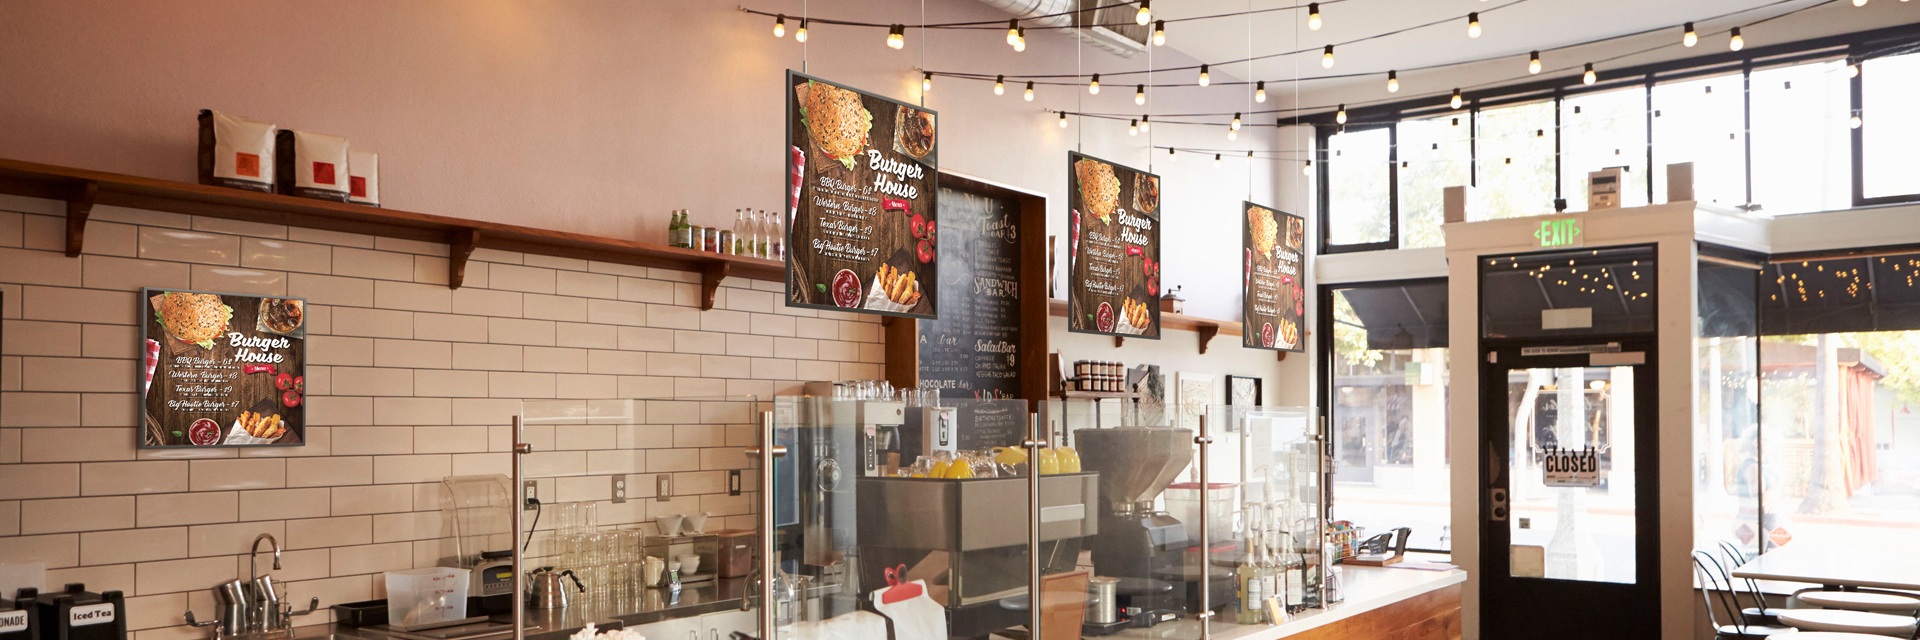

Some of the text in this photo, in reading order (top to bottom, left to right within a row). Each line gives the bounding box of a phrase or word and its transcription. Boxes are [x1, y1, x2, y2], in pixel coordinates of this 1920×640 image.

[868, 149, 924, 181] Burger
[820, 176, 834, 190] BBQ
[836, 180, 857, 194] Burger
[874, 172, 918, 199] House
[813, 196, 840, 209] Western
[843, 201, 864, 215] Burger
[820, 218, 837, 229] Texas
[838, 220, 858, 234] Burger
[978, 214, 1010, 235] Toast
[1118, 208, 1152, 232] Burger
[1121, 227, 1148, 246] House
[1541, 219, 1575, 247] EXIT
[845, 244, 866, 257] Burger
[1276, 246, 1298, 264] Burger
[1278, 260, 1296, 276] House
[974, 276, 1018, 299] SANDWICH
[986, 289, 1004, 297] BAR
[228, 332, 290, 352] Burger
[975, 339, 1016, 353] Salad Bar
[193, 357, 215, 367] Burger
[235, 348, 284, 363] House
[169, 370, 197, 378] Western
[200, 371, 223, 381] Burger
[194, 385, 217, 395] Burger
[920, 379, 956, 389] HOCOLATE
[203, 400, 225, 410] Burger
[1546, 455, 1596, 472] CLOSED
[0, 615, 24, 627] ONADE
[74, 610, 112, 620] Iced Tea
